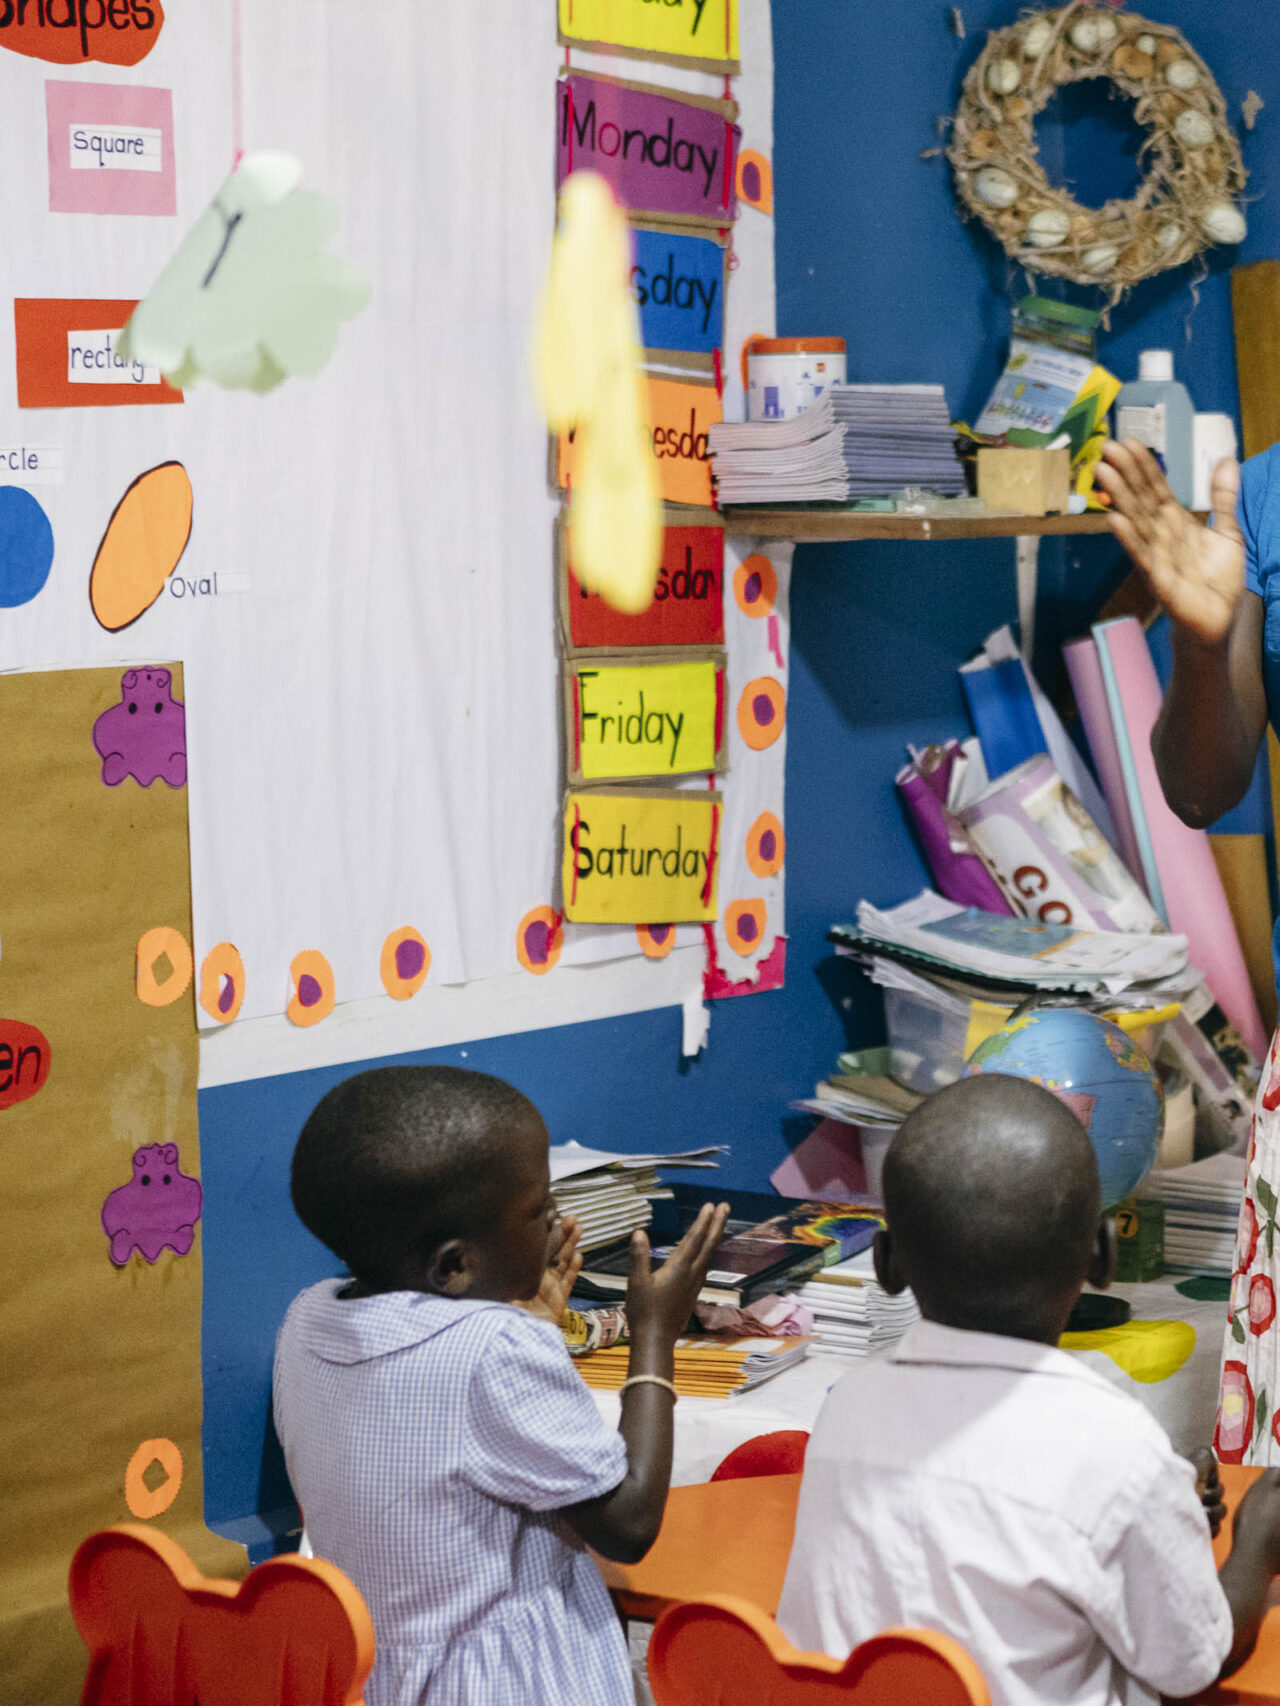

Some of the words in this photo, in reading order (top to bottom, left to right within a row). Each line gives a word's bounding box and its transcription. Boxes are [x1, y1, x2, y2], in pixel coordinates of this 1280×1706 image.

[0, 0, 154, 56] apes
[73, 131, 144, 167] Square
[562, 93, 718, 197] Monday
[630, 254, 717, 333] sday
[170, 572, 218, 598] Oval
[577, 671, 684, 767] Friday
[570, 820, 718, 901] Saturday
[1119, 1213, 1134, 1235] 7
